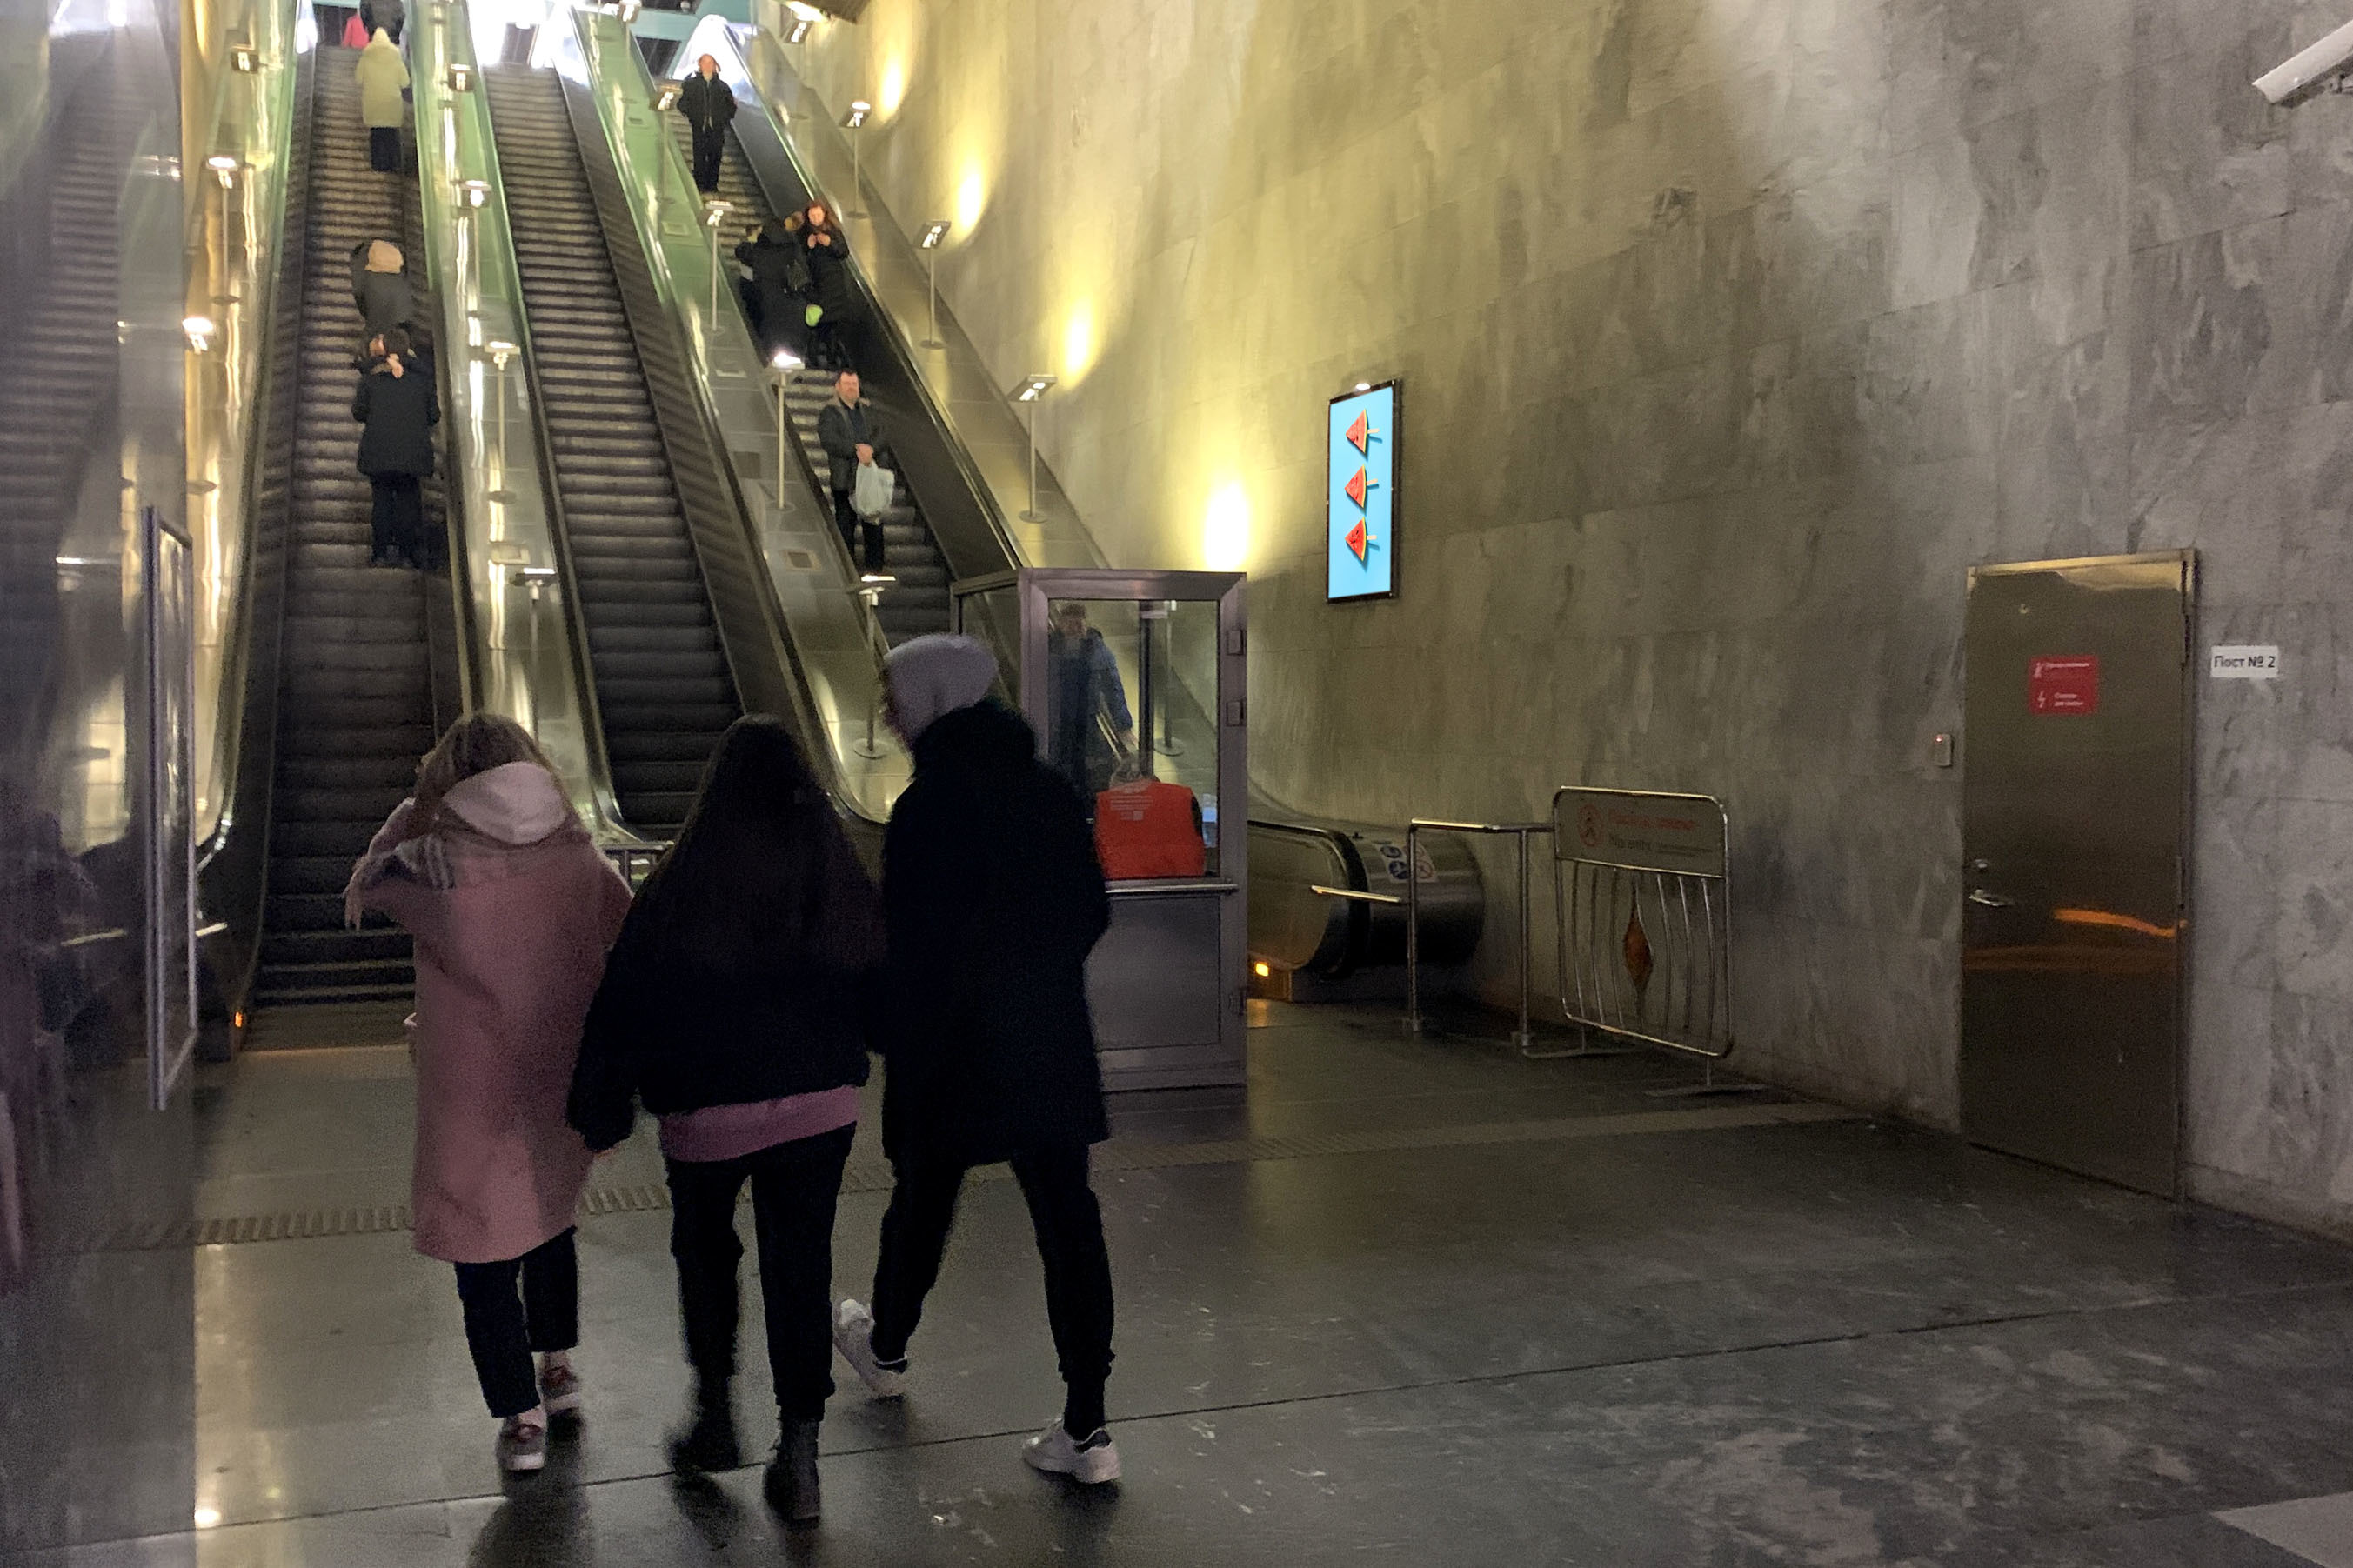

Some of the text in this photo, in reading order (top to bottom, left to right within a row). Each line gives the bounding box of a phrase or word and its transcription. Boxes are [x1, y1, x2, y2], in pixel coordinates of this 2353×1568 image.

[2214, 655, 2276, 668] Пост № 2
